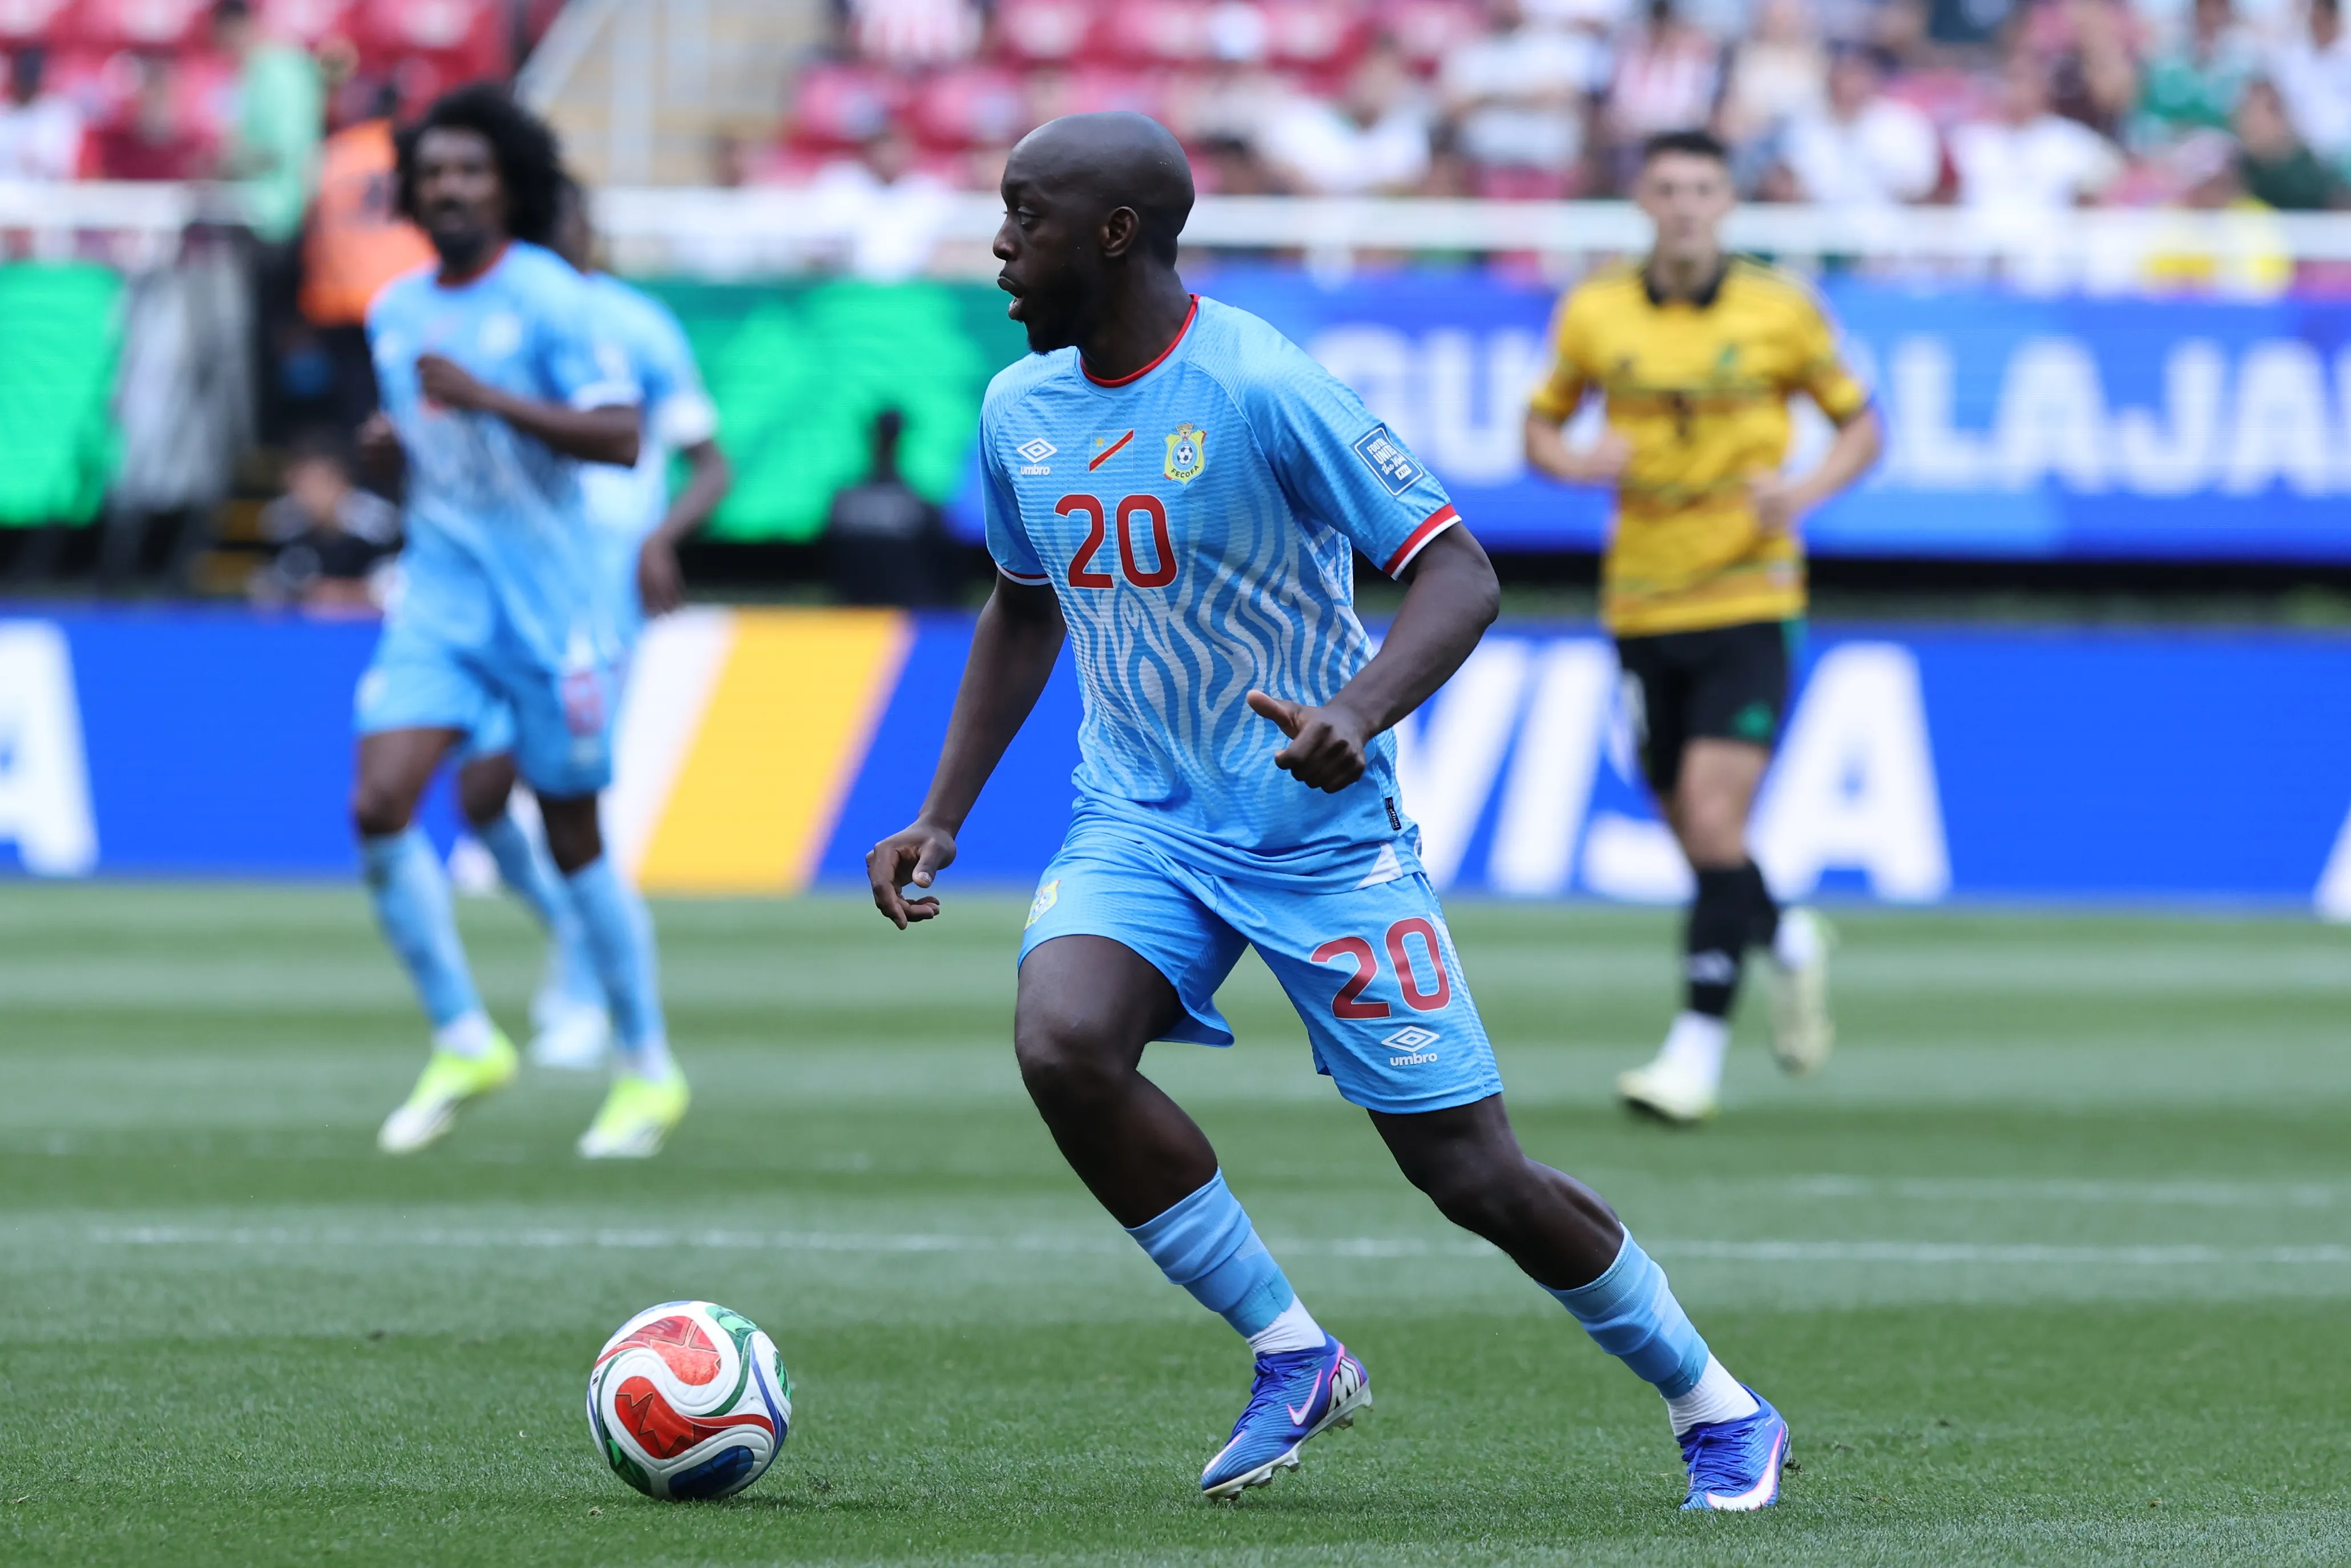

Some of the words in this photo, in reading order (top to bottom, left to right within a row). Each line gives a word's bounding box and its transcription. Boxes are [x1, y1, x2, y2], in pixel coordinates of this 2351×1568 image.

[1309, 321, 2351, 495] GULAJA
[1020, 464, 1051, 475] umbro
[1171, 465, 1199, 478] FECOFA
[1054, 493, 1178, 589] 20
[1309, 917, 1451, 1019] 20
[1390, 1053, 1438, 1066] umbro
